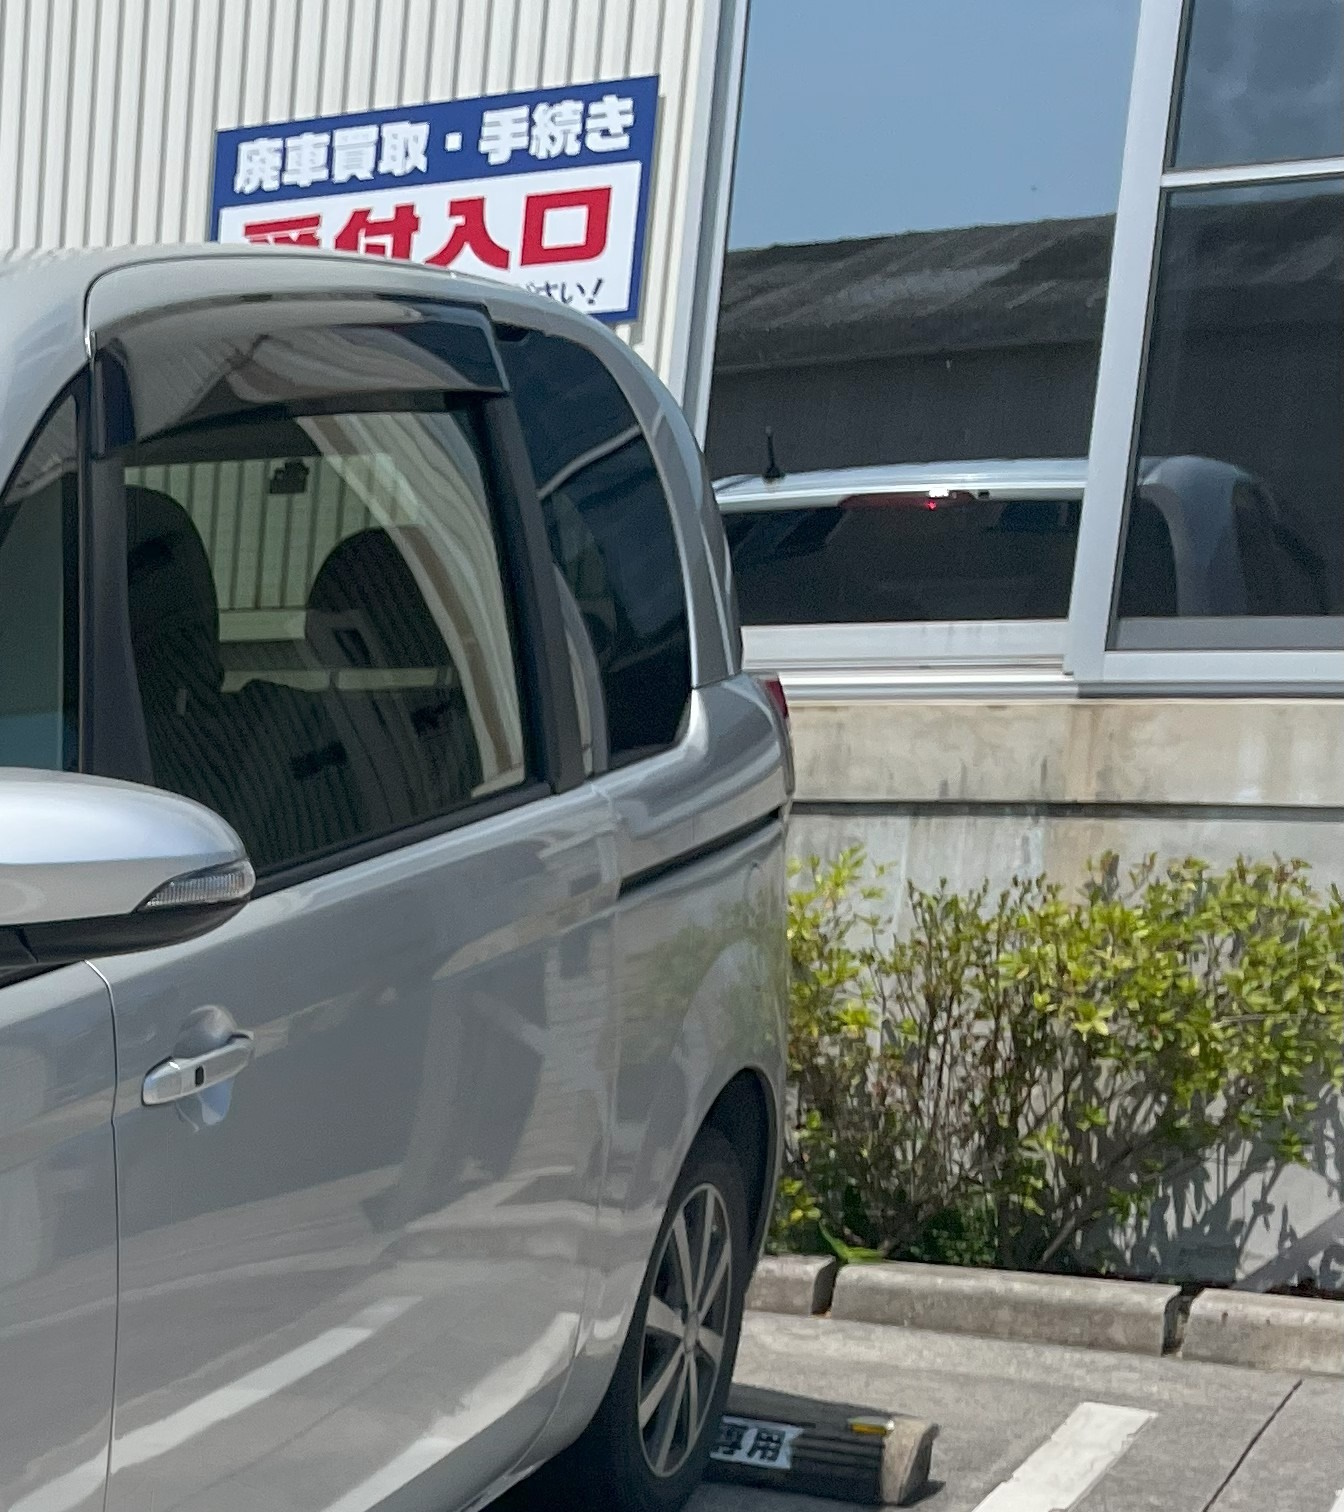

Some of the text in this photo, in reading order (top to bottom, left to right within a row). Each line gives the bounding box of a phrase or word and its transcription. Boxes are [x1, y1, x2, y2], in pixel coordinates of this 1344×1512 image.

[233, 94, 635, 195] 廃車買取・手続き
